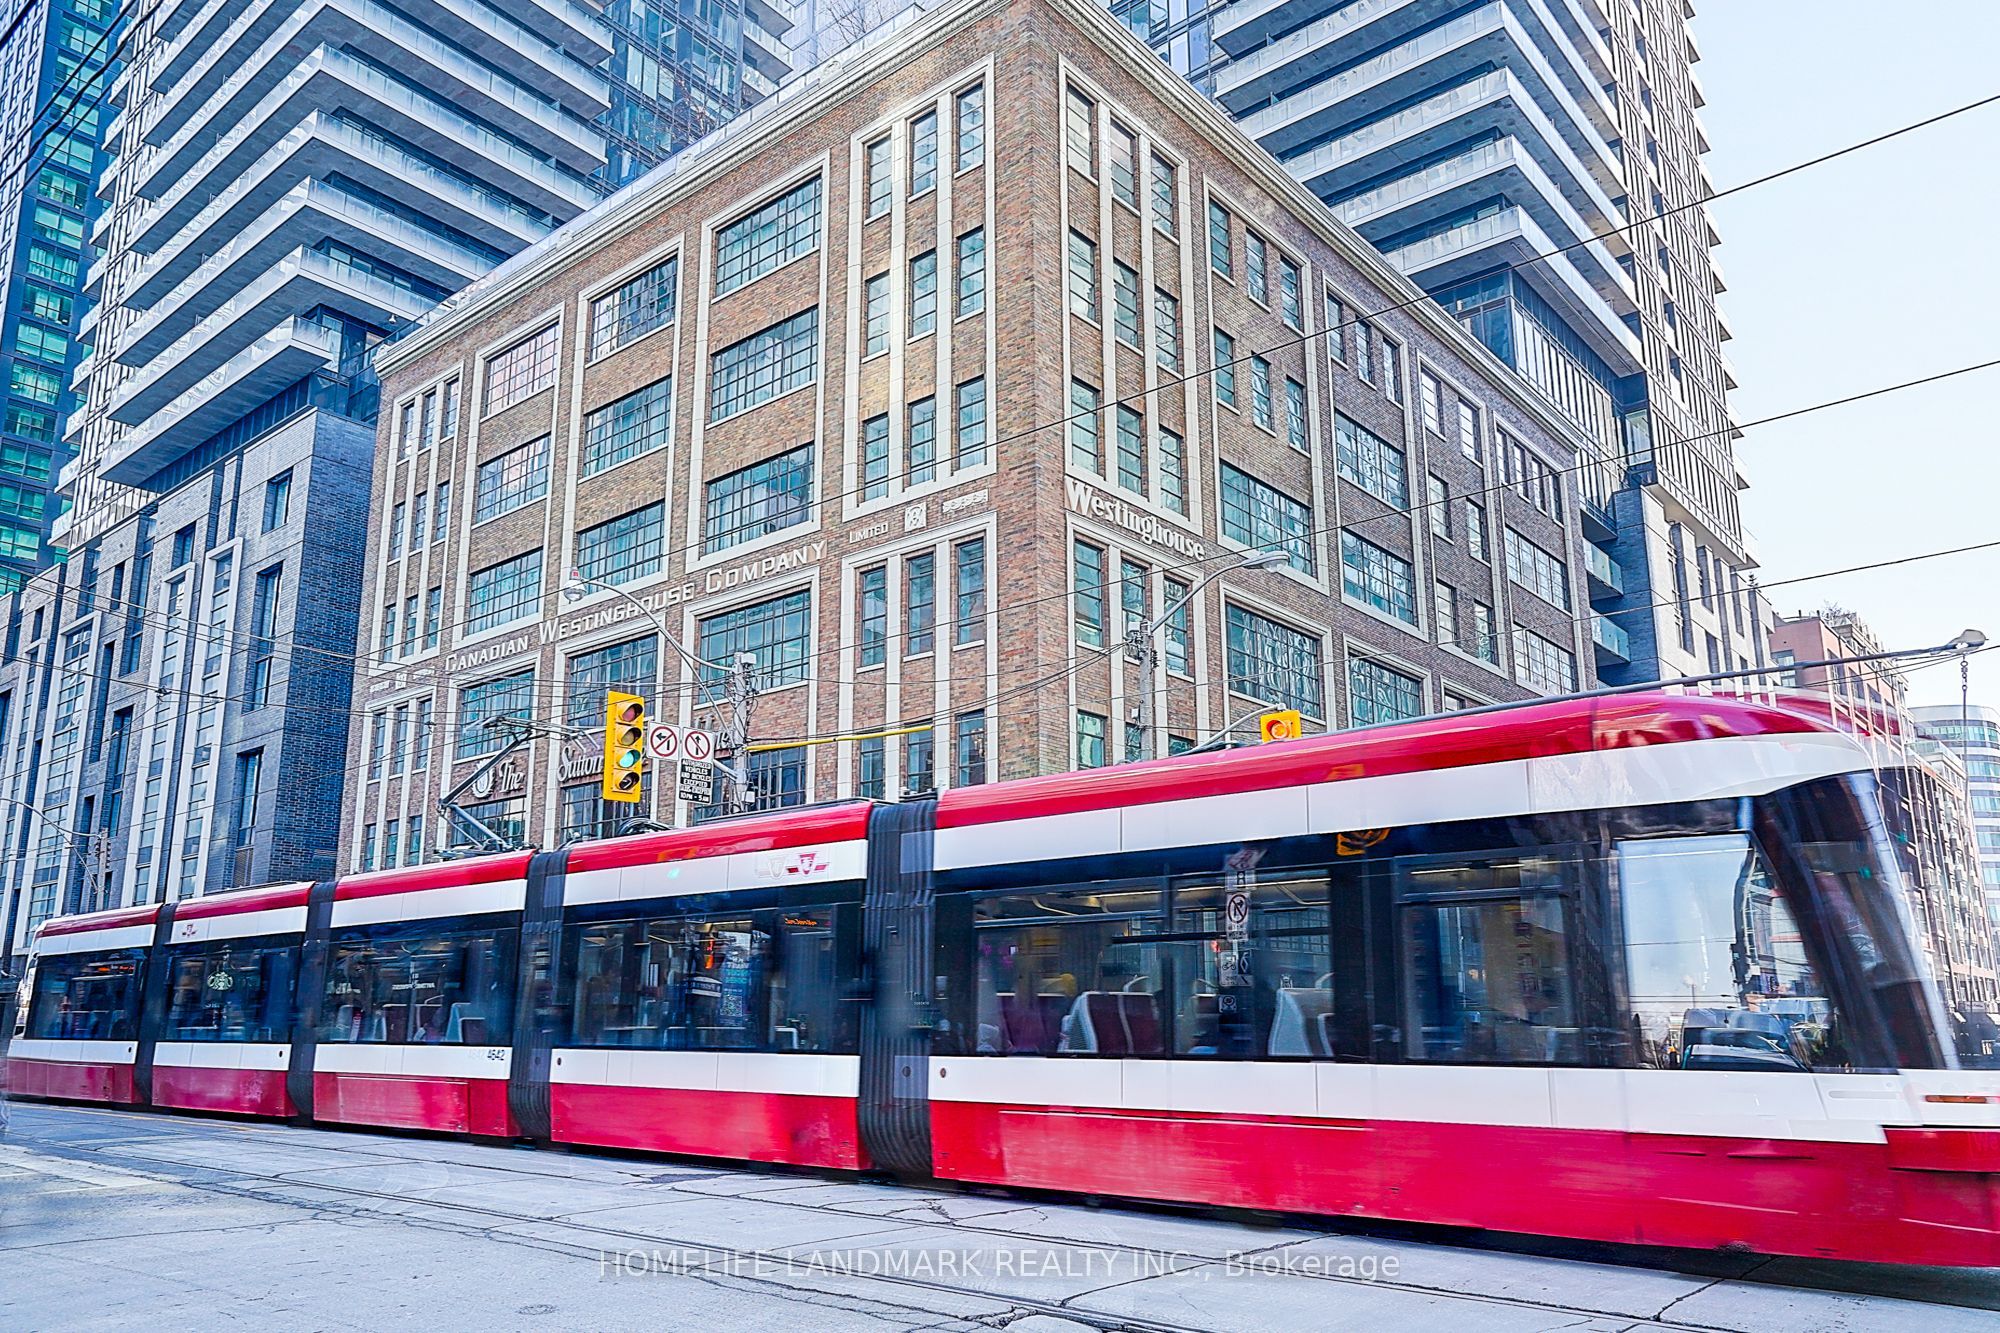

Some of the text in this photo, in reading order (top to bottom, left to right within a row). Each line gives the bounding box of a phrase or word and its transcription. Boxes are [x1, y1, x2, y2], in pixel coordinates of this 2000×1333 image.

[1064, 475, 1206, 561] Westinghouse
[445, 522, 889, 675] CANADIAN WESTINGHOUSE COMPANY LIMITED
[499, 745, 604, 794] The Sutton
